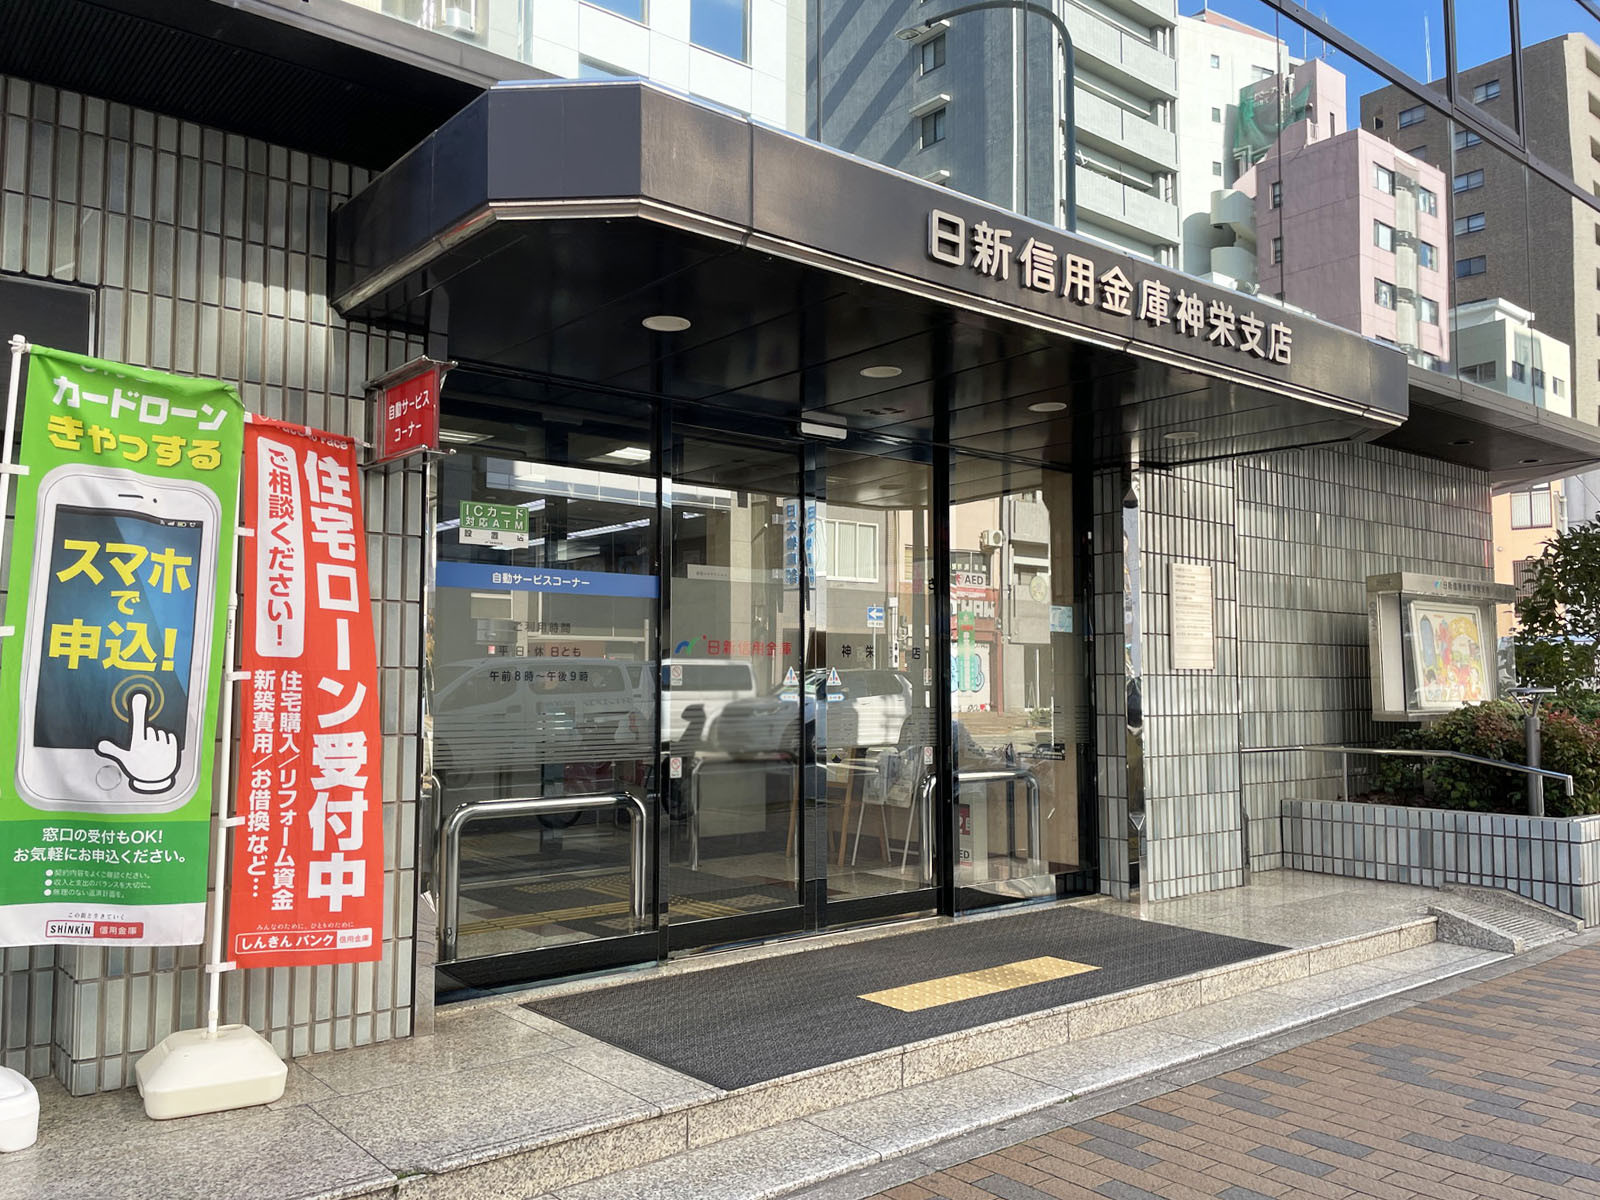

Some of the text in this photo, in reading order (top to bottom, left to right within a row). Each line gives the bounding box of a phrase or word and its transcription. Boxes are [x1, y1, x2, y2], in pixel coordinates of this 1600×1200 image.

[928, 208, 1293, 364] 日新信用金庫神栄支店
[52, 375, 228, 431] カードローン
[389, 390, 430, 420] 自動サービス
[394, 421, 422, 442] コーナー
[47, 415, 222, 471] きゃっする
[466, 504, 524, 519] ICカード
[466, 517, 524, 530] 対応ATM
[267, 447, 295, 646] ご相談ください!
[56, 539, 192, 594] スマホ
[492, 572, 590, 588] 自動サービスコーナー
[964, 574, 984, 585] AED
[111, 590, 140, 615] で
[48, 618, 178, 671] 申込!
[707, 640, 792, 656] 日新信用金庫
[841, 643, 920, 659] 神栄店
[302, 450, 369, 912] 住宅ローン受付中
[271, 670, 304, 911] 住宅購入/リフォーム資金
[41, 827, 163, 844] 窓口の受付もOK!
[13, 847, 187, 865] お気軽にお申込ください。
[99, 925, 138, 935] 信用金庫
[338, 934, 369, 944] 信用金庫
